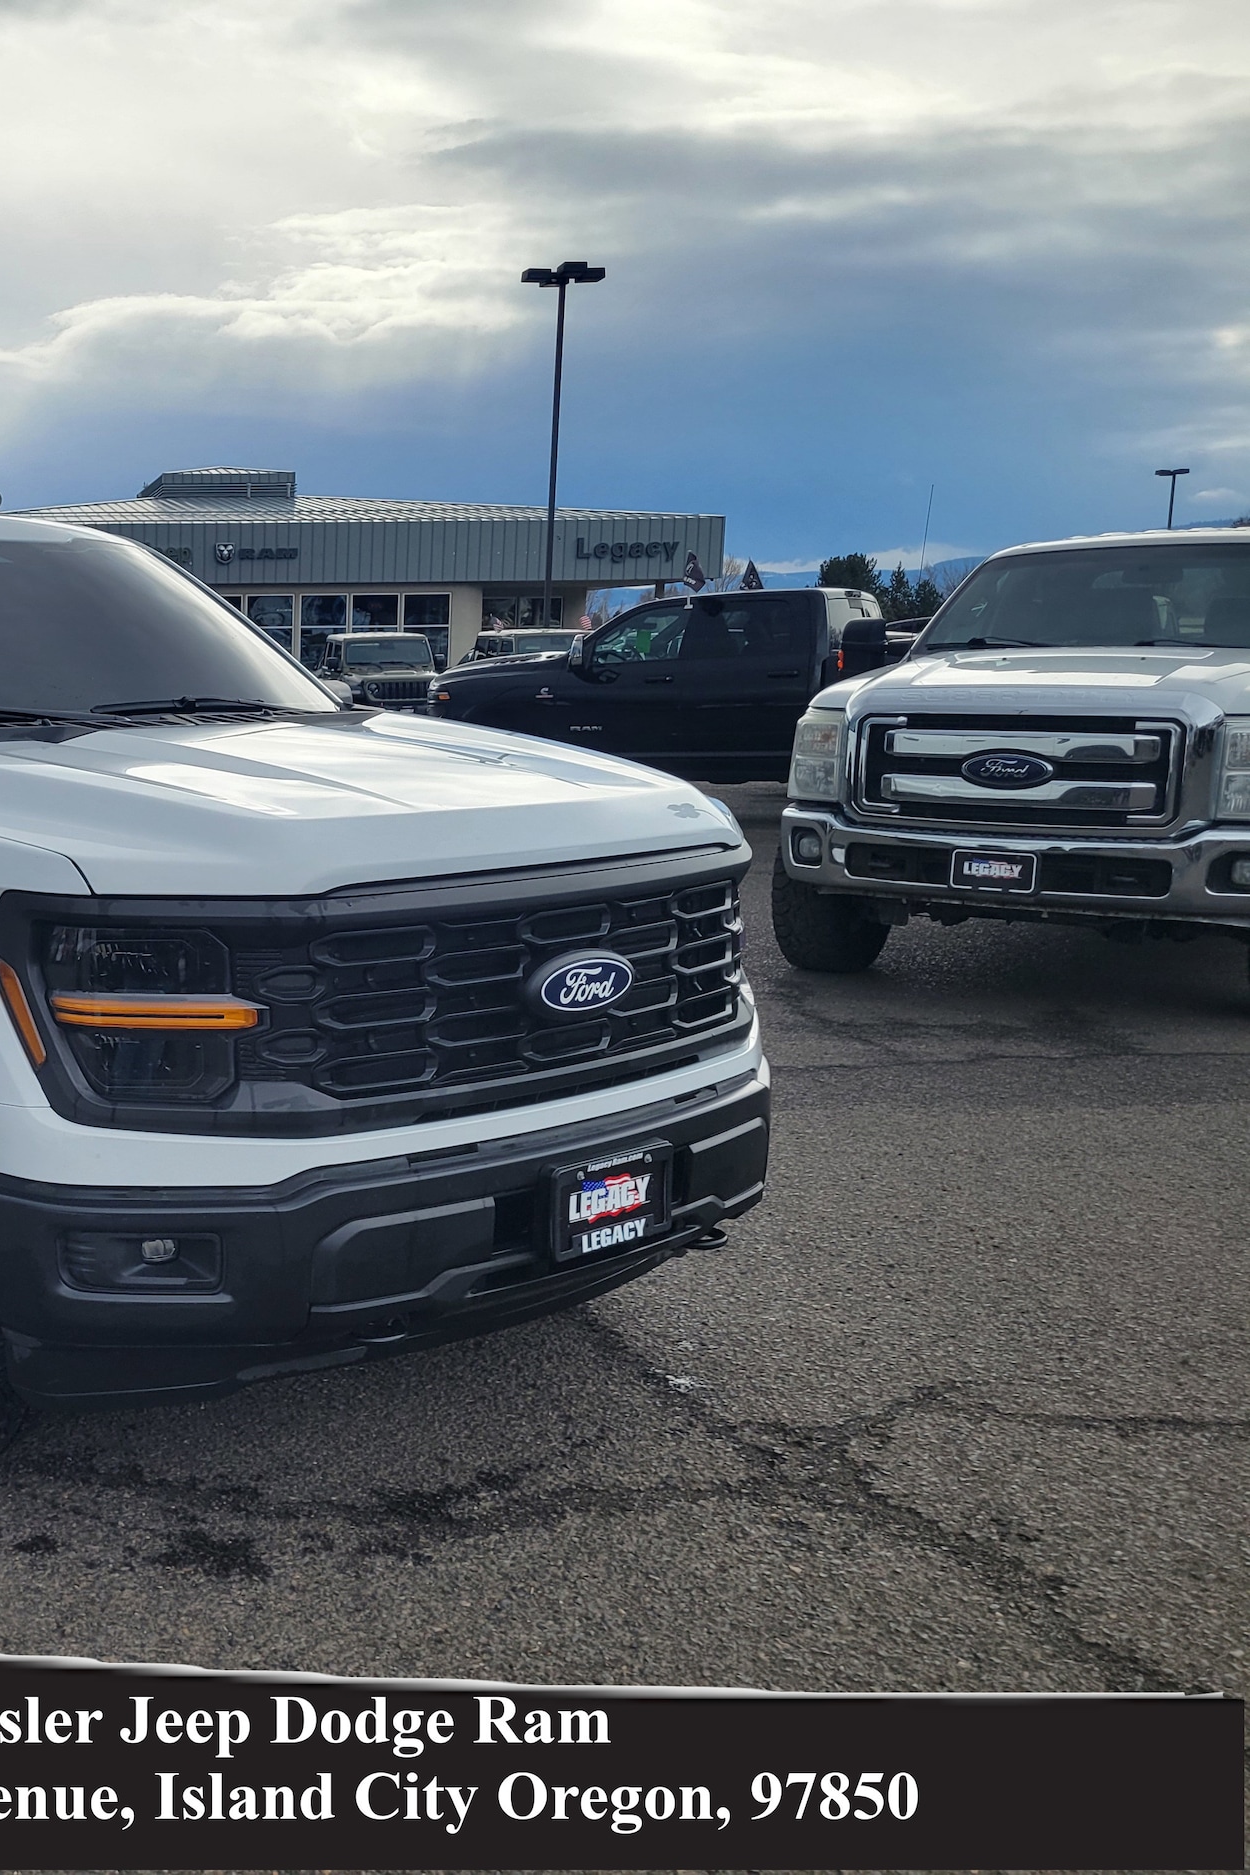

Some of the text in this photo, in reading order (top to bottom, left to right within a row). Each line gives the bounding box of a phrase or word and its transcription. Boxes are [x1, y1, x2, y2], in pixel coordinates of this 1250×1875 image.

[239, 548, 298, 560] RAM
[576, 537, 680, 563] Legacy
[980, 757, 1030, 779] Ford
[963, 860, 1024, 879] LEGACY
[559, 966, 615, 1004] Ford
[569, 1176, 650, 1222] LEGACY
[581, 1218, 647, 1253] LEGACY
